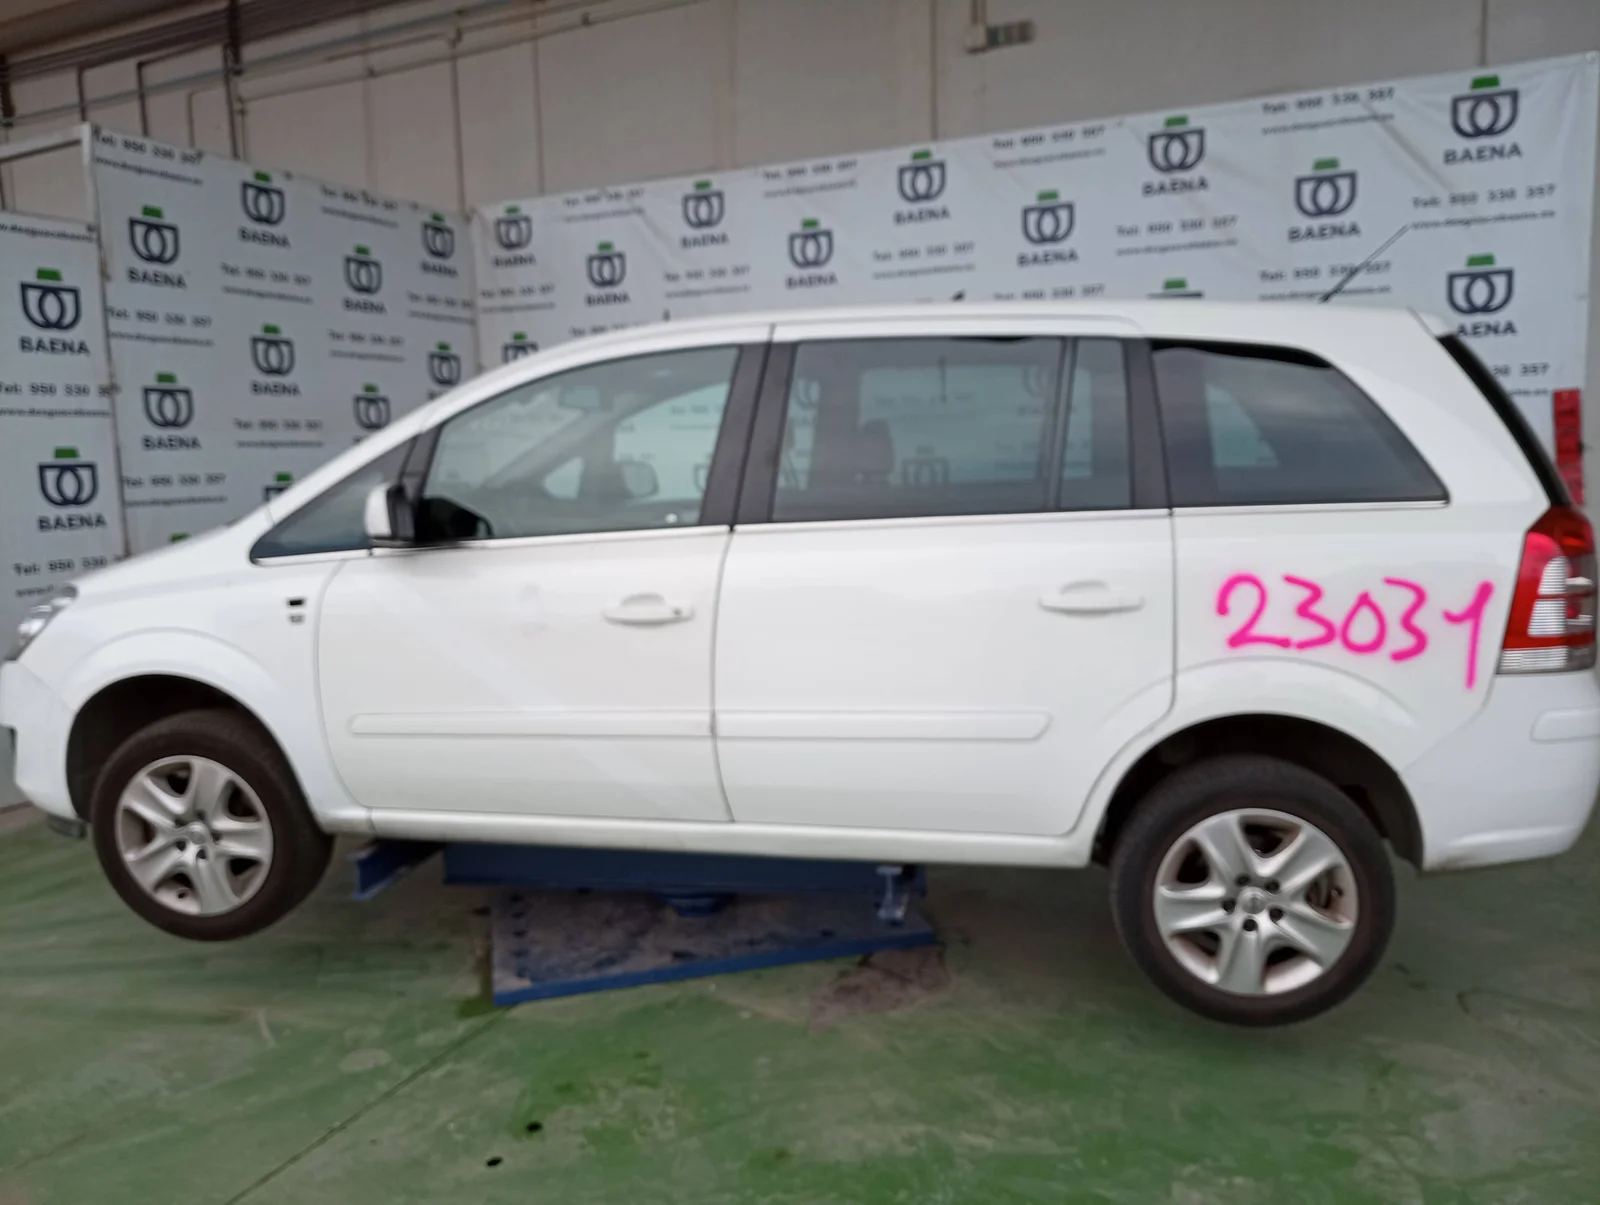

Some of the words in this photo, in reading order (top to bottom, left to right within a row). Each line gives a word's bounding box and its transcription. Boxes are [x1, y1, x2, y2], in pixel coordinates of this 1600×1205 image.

[1443, 142, 1522, 164] BAENA
[1141, 176, 1209, 197] BAENA
[894, 206, 951, 225] BAENA
[238, 227, 291, 249] BAENA
[1287, 221, 1362, 243] BAENA
[1016, 248, 1079, 268] BAENA
[127, 267, 188, 291] BAENA
[786, 272, 838, 290] BAENA
[1457, 320, 1518, 337] AENA
[20, 335, 90, 355] BAENA
[251, 380, 302, 397] BAENA
[142, 434, 202, 451] BAENA
[38, 514, 107, 532] BAENA
[1214, 571, 1495, 690] 23031
